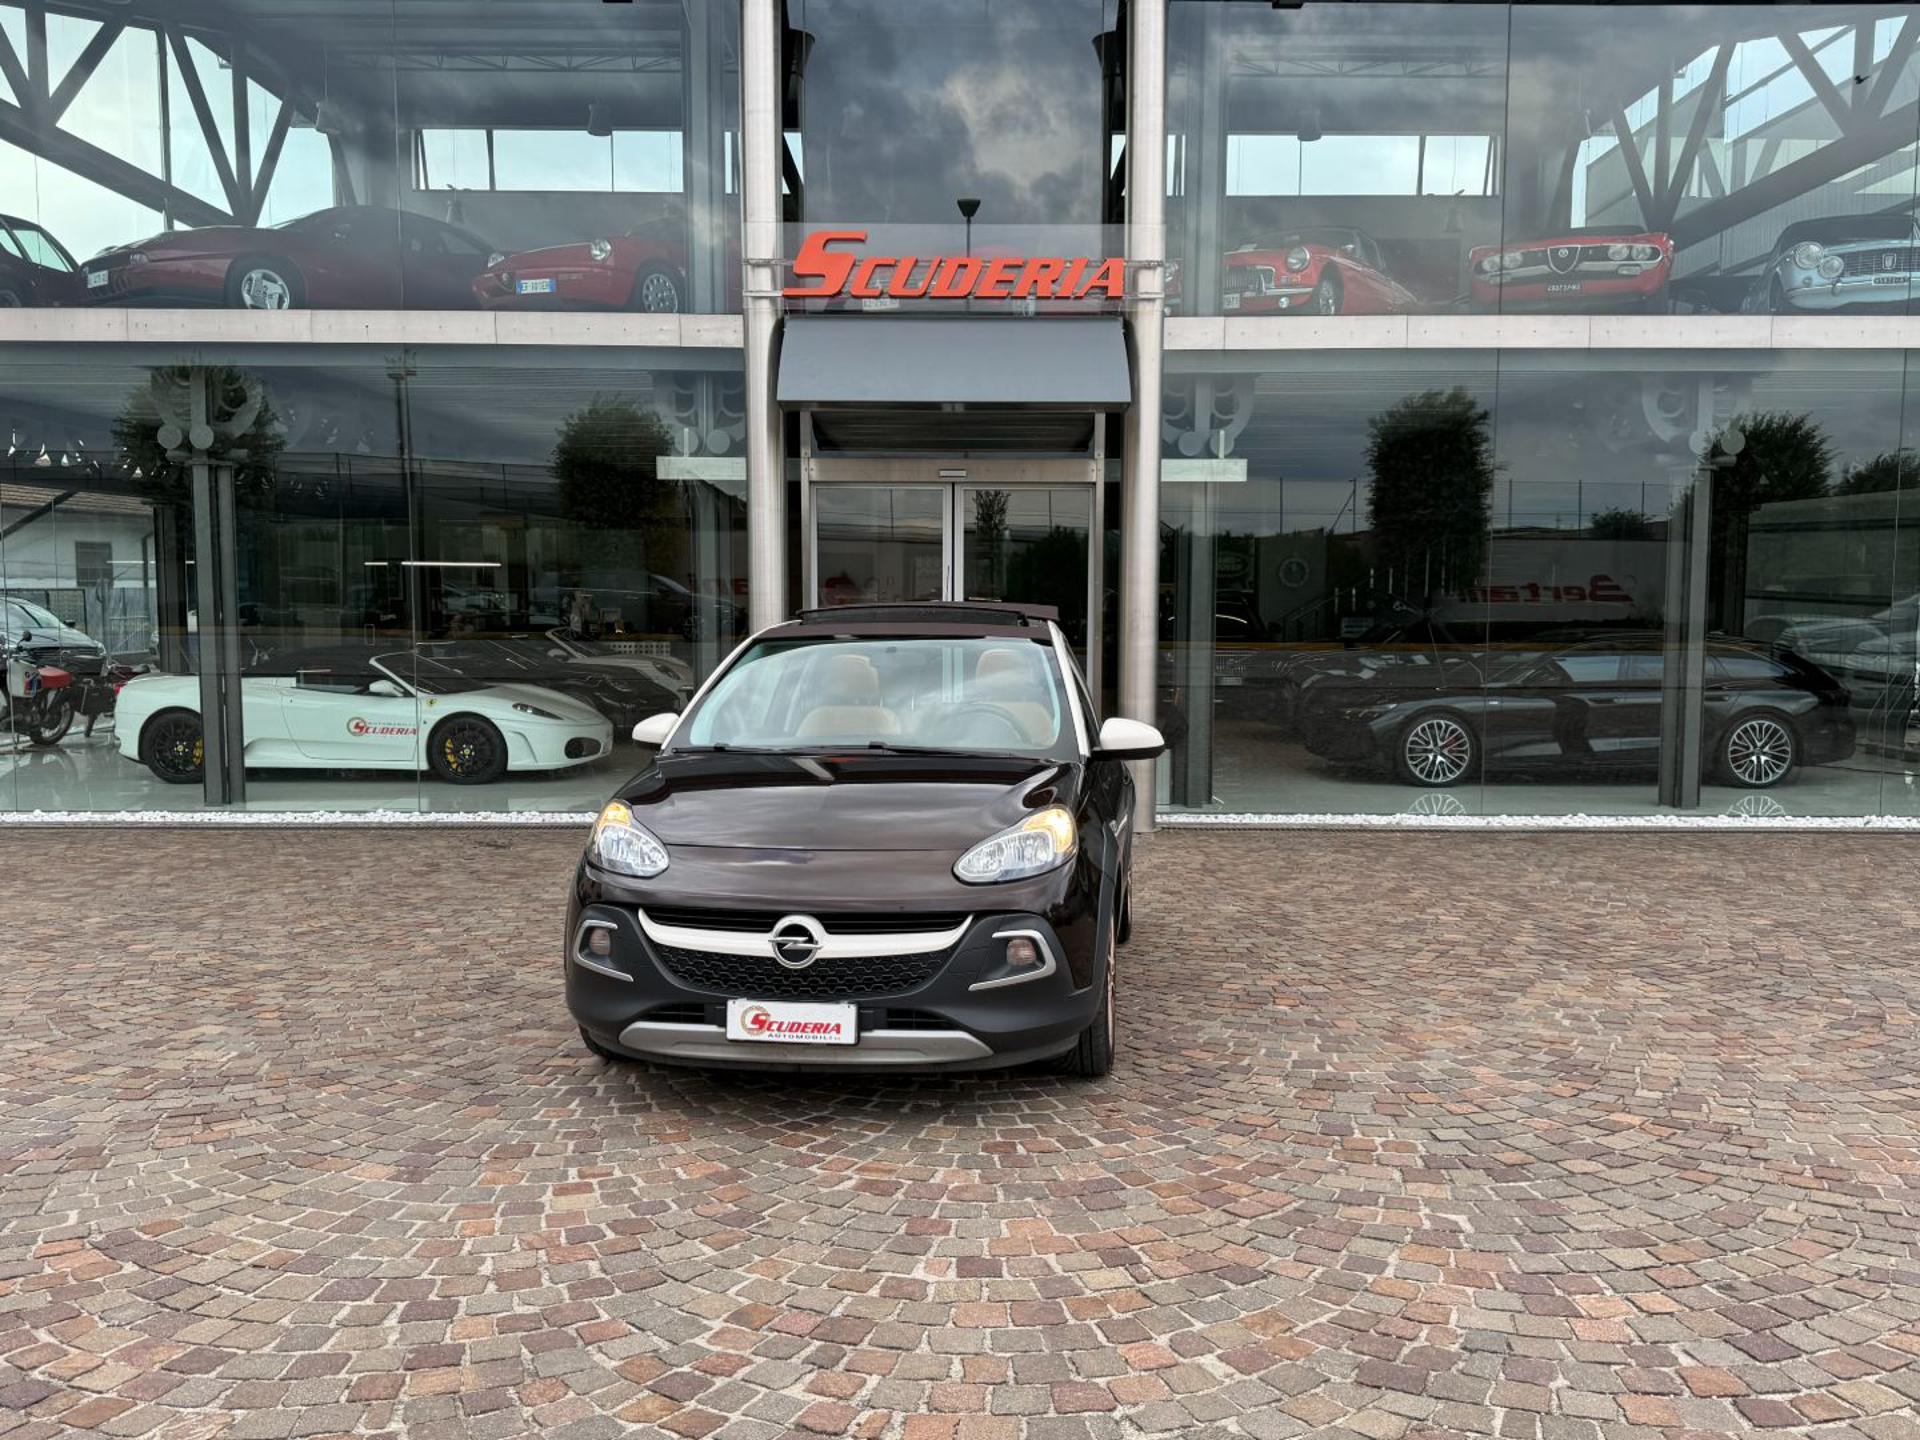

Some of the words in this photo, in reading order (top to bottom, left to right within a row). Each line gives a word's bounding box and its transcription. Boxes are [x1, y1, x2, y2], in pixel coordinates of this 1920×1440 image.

[782, 230, 1125, 299] SCUDERIA
[353, 721, 417, 736] SCUDERIA
[746, 1012, 842, 1034] SCUDERIA
